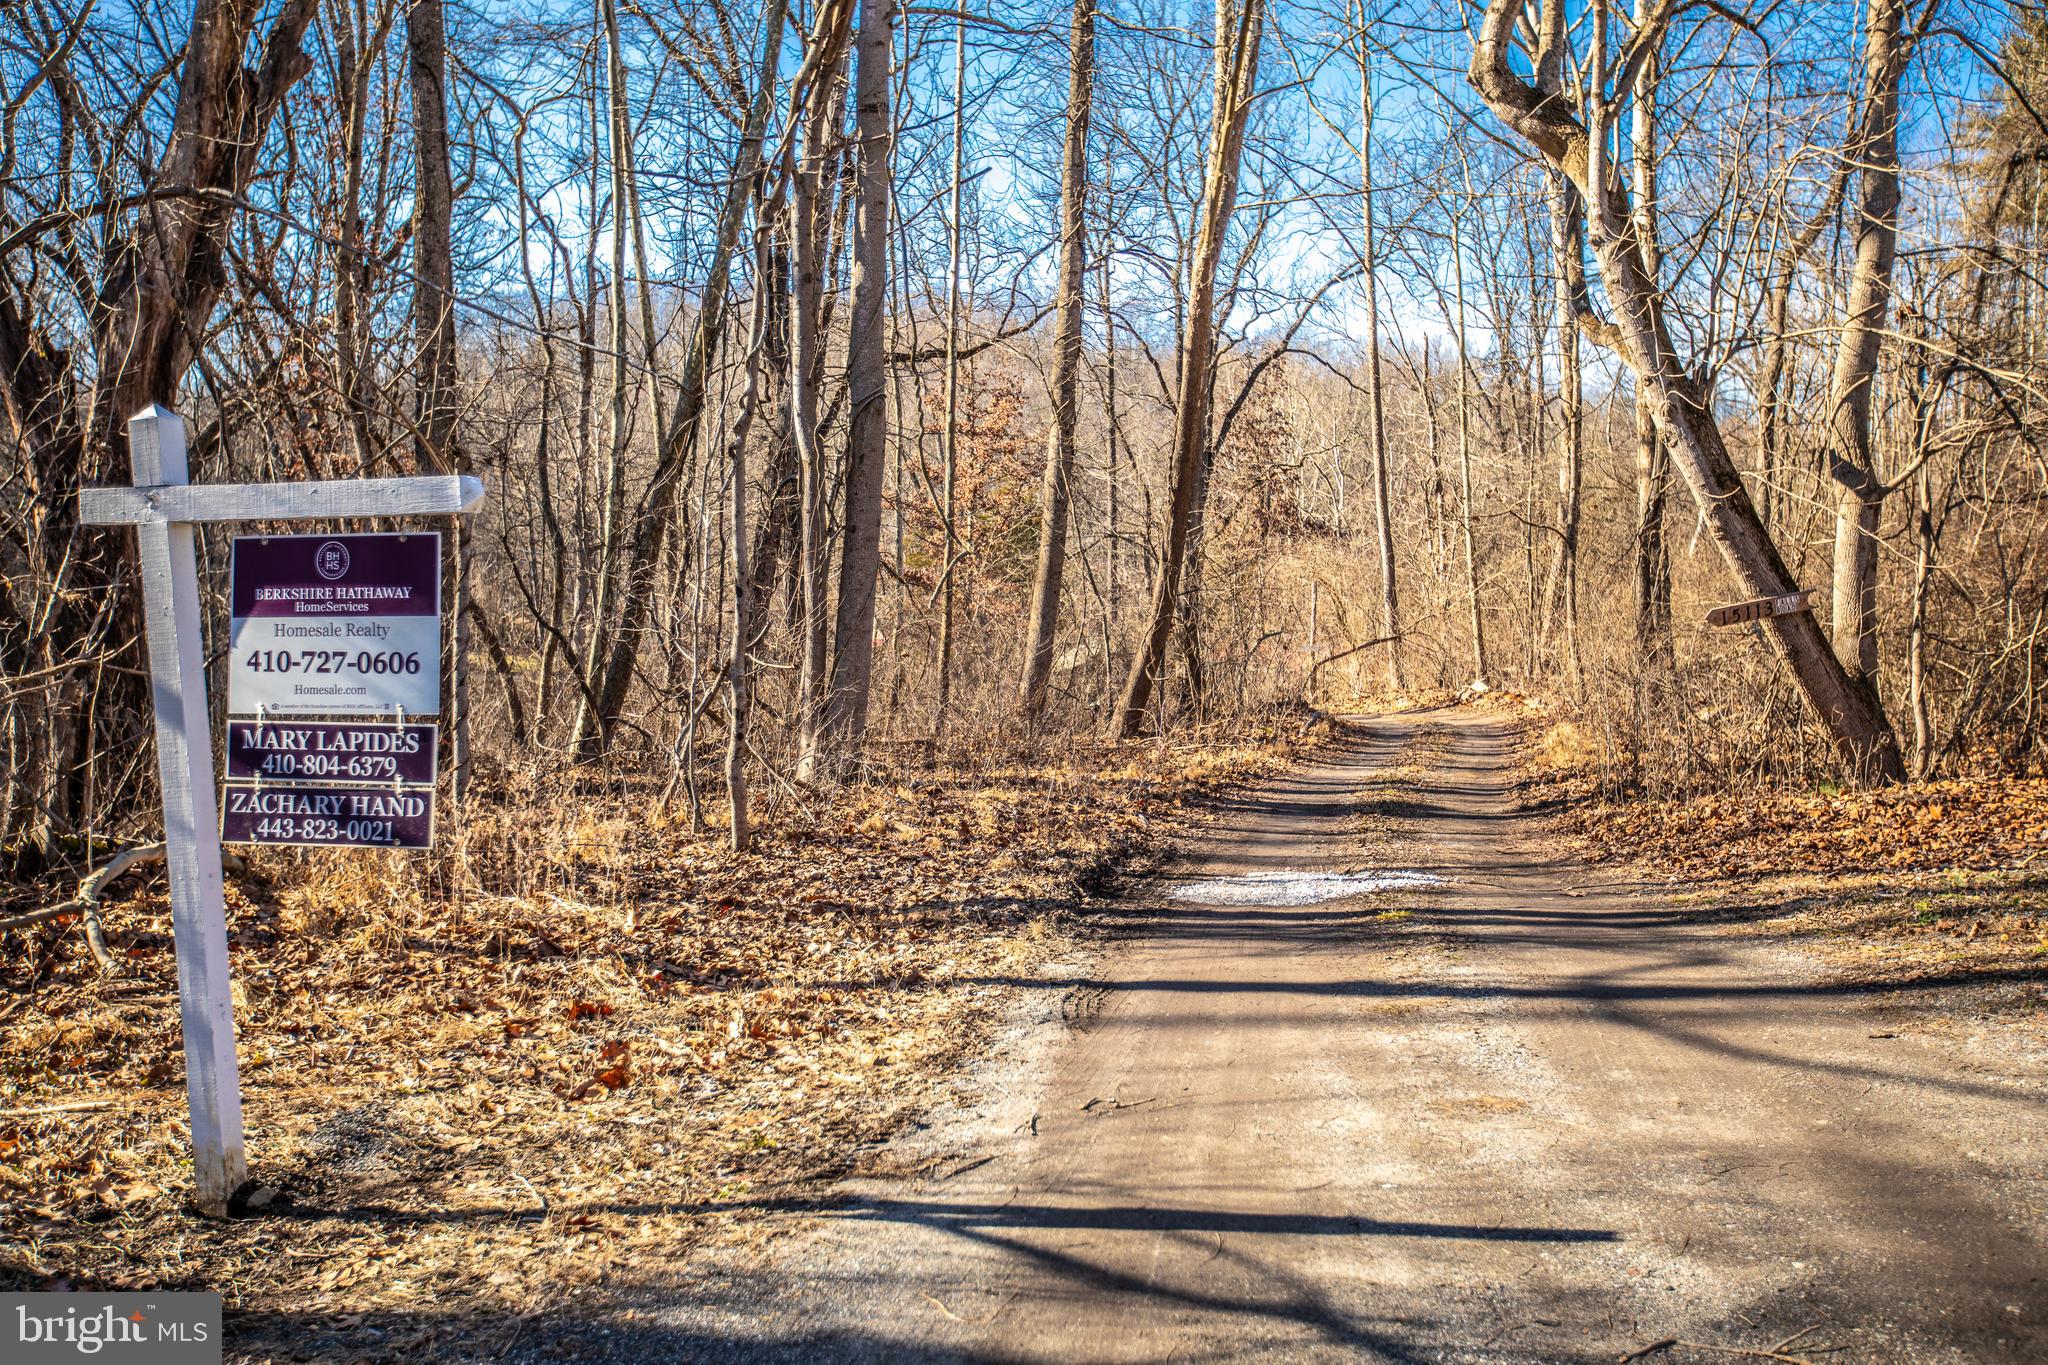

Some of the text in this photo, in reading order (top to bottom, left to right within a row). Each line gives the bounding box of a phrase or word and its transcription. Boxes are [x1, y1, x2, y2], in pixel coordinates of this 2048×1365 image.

[326, 551, 340, 561] BH
[326, 560, 340, 570] HS
[255, 586, 412, 600] BERKSHIRE HATHAWAY
[295, 601, 369, 612] HomeServices
[1721, 601, 1774, 625] 15113
[274, 622, 391, 640] Homesale Realty
[247, 650, 420, 674] 410-727-0606
[294, 685, 367, 695] Homesale.com
[242, 729, 420, 753] MARY LAPIDES
[262, 753, 397, 777] 410-804-6379
[230, 793, 425, 817] ZACHARY HAND
[257, 818, 394, 841] 443-823-0021
